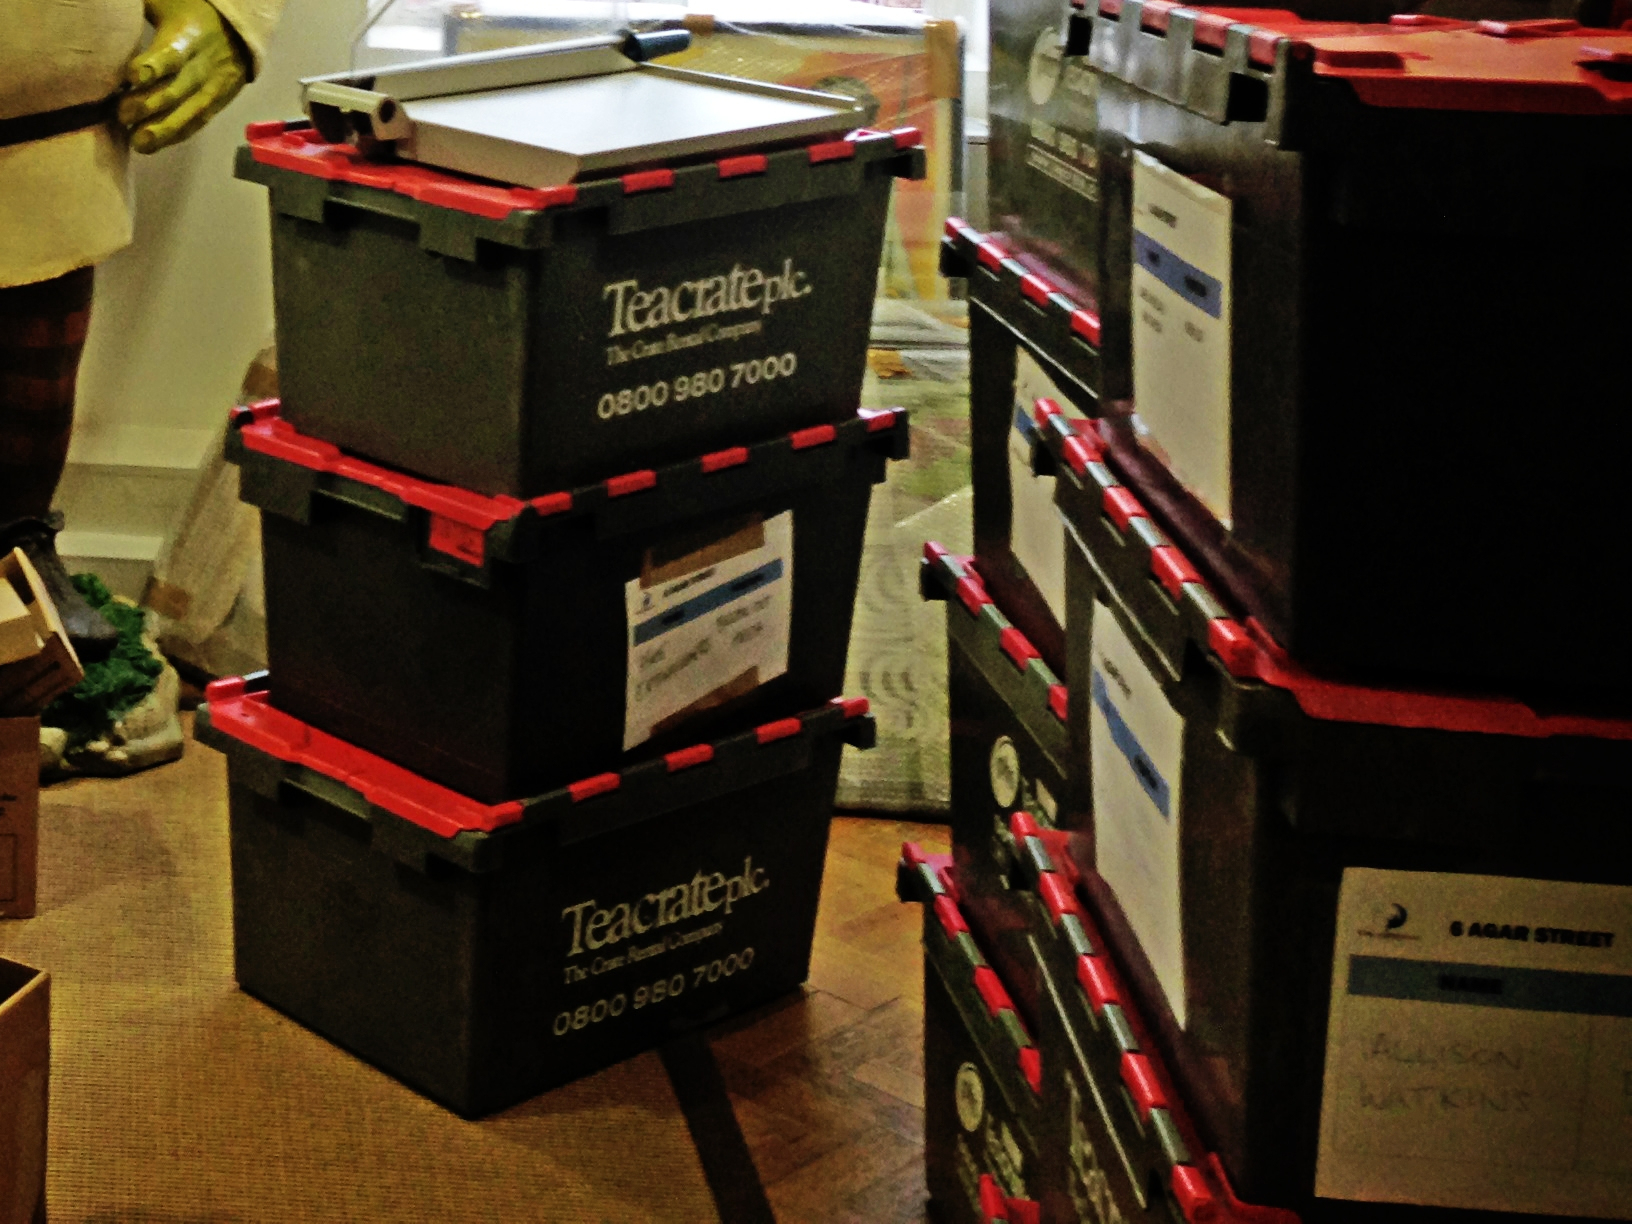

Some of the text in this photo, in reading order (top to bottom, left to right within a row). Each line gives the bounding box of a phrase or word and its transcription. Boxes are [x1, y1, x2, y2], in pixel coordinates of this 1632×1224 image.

[597, 352, 798, 419] 0800 980 7000
[1467, 922, 1531, 943] AGAR
[1533, 925, 1616, 949] STREET
[553, 946, 756, 1036] 0800 980 7000
